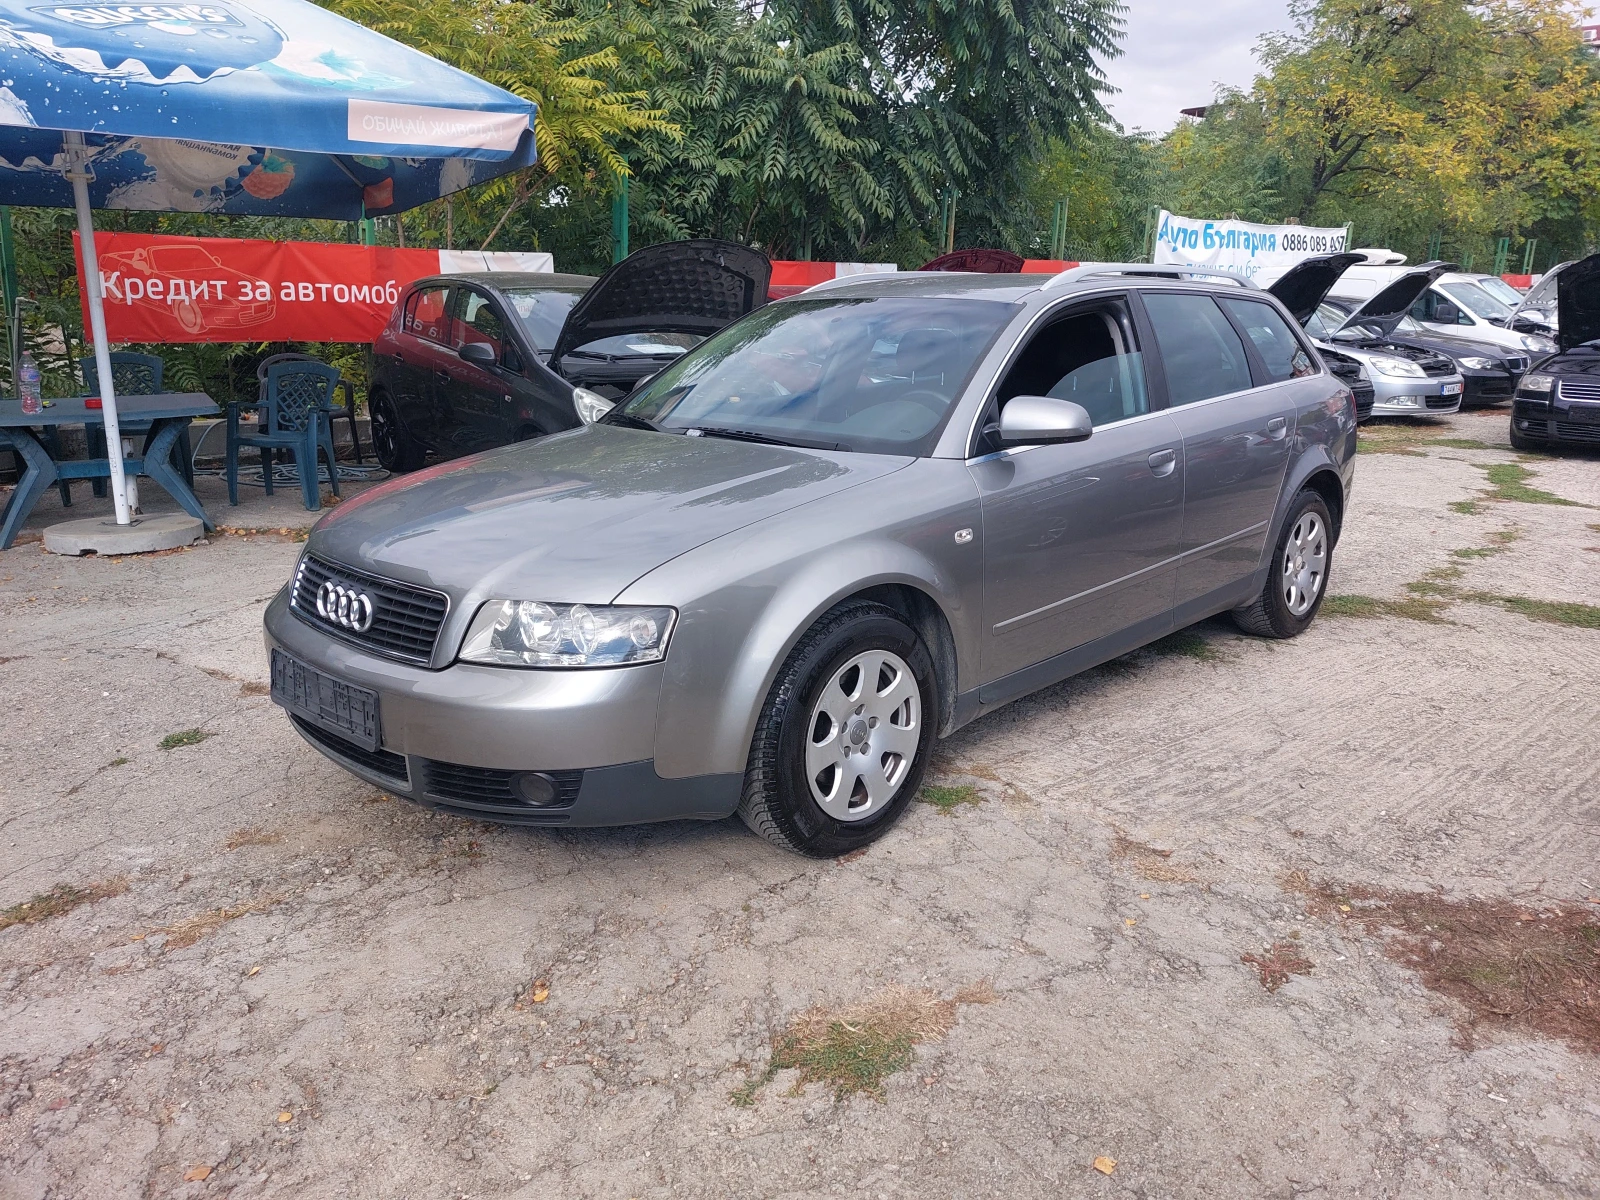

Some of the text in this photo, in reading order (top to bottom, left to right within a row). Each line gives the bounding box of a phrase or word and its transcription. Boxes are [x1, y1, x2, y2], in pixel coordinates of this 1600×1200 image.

[54, 4, 226, 24] QUEEN'S
[362, 114, 428, 136] ОБИЧАЙ
[1203, 223, 1276, 257] България
[1282, 234, 1308, 251] 0886
[1310, 235, 1327, 252] 089
[98, 271, 401, 305] Кредит за автомоб
